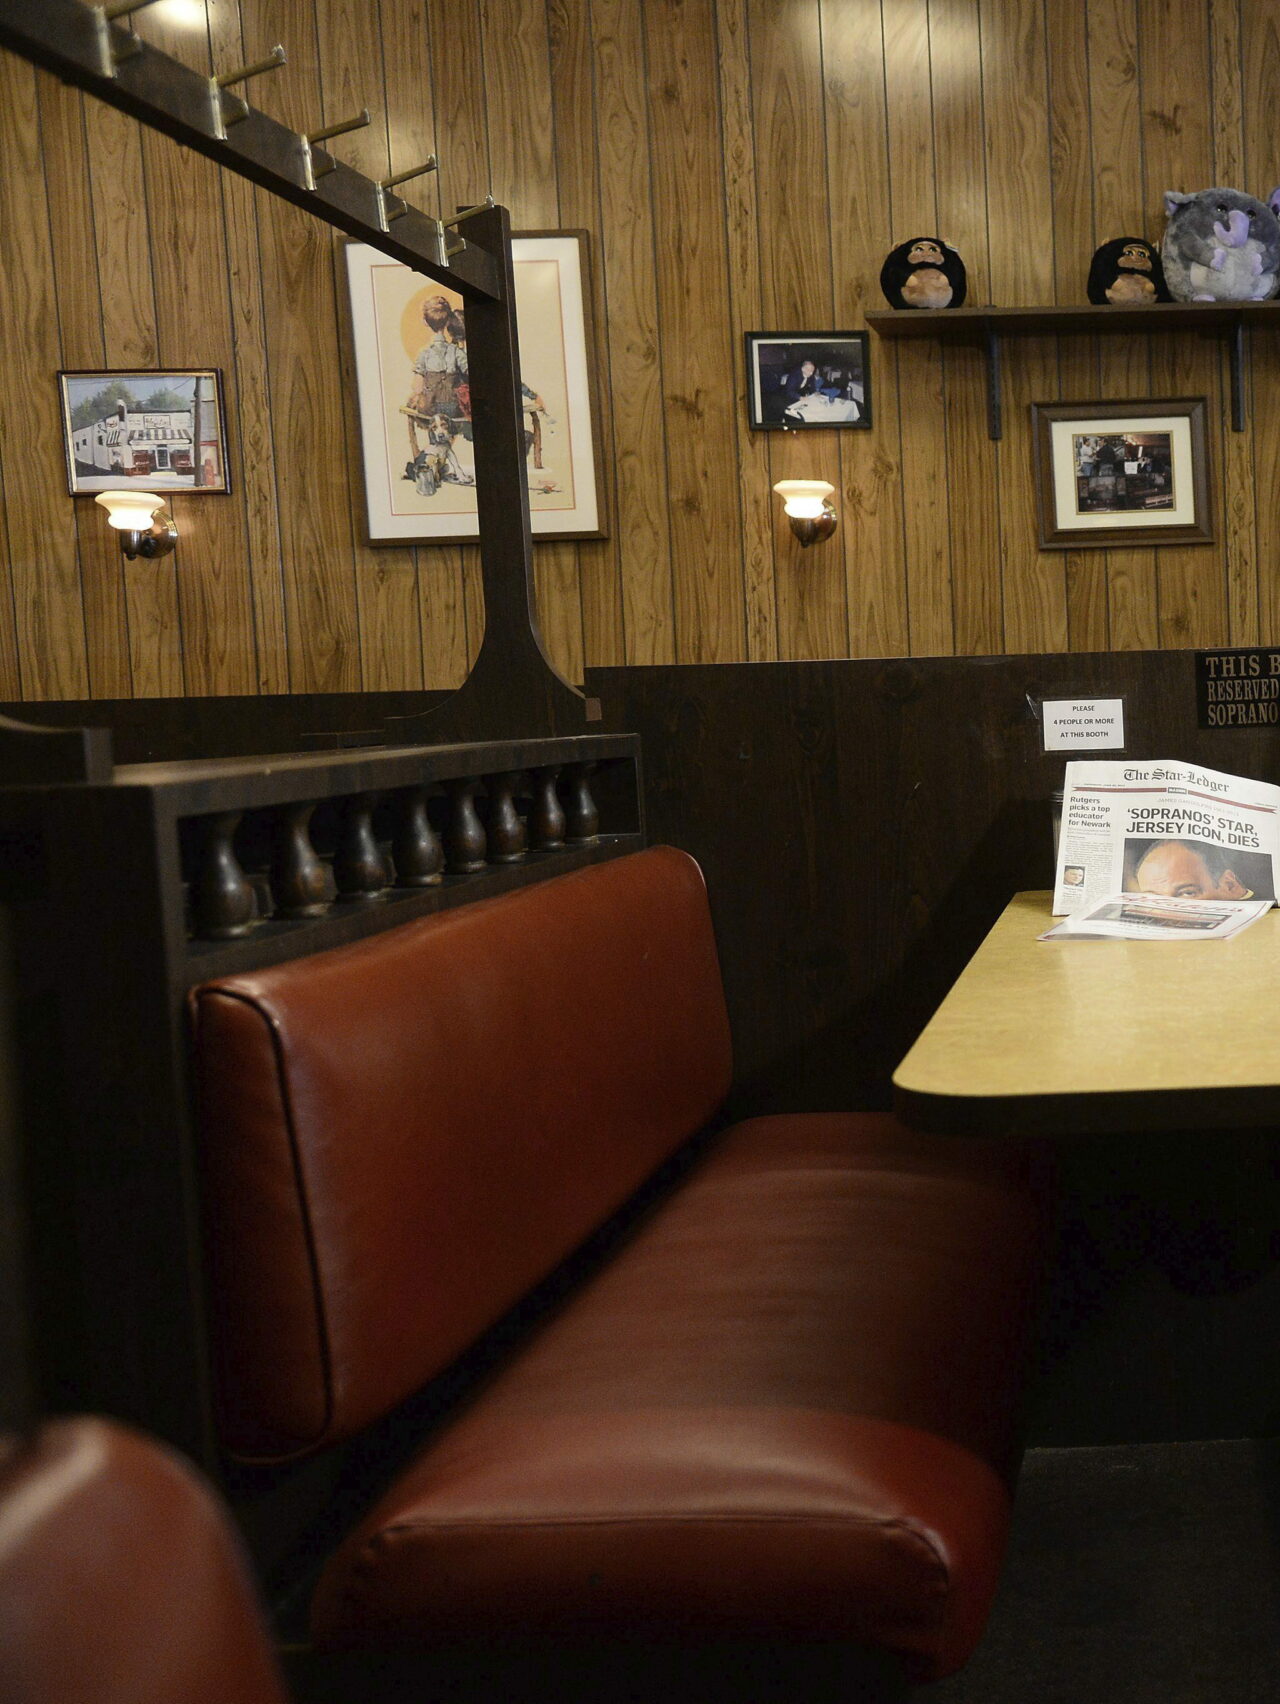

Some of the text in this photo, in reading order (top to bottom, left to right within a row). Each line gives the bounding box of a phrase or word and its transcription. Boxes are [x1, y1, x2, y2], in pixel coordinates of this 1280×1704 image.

[1206, 654, 1260, 678] THIS
[1207, 678, 1280, 702] RESERVED
[1208, 702, 1279, 726] SOPRANO
[1124, 768, 1230, 793] The Star-Ledger
[1069, 804, 1090, 812] picks
[1097, 805, 1111, 814] top
[1070, 796, 1101, 805] Rutgers
[1069, 811, 1104, 820] educator
[1081, 820, 1111, 829] Newark
[1126, 821, 1260, 848] JERSEY ICON, DIES
[1217, 817, 1258, 836] STAR,
